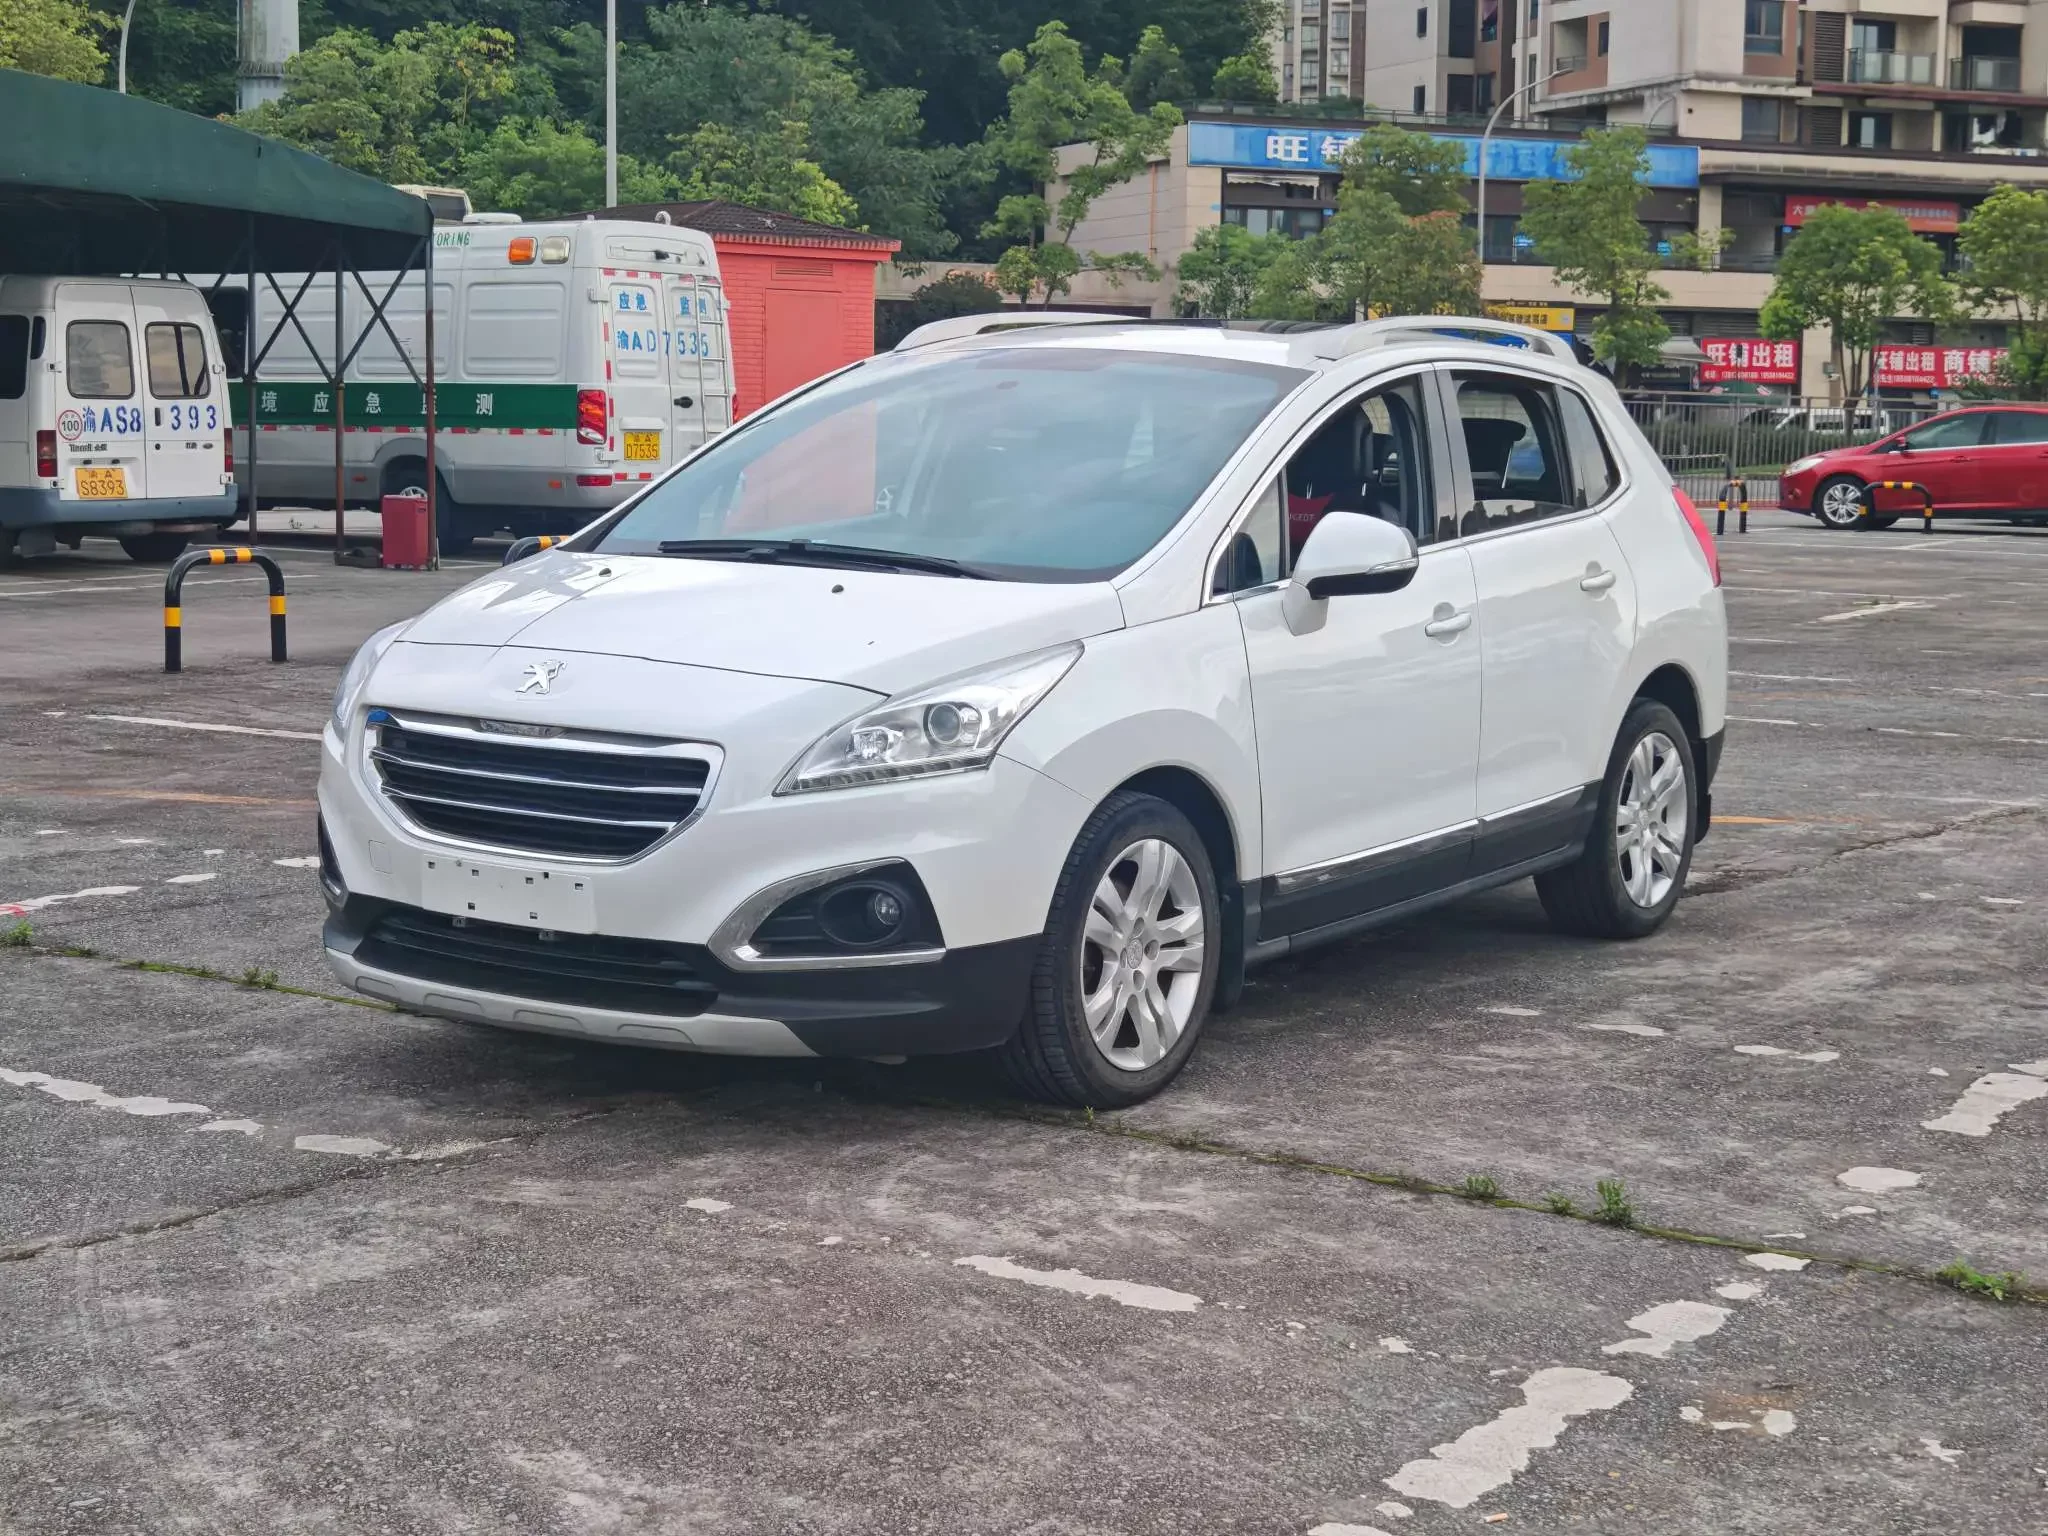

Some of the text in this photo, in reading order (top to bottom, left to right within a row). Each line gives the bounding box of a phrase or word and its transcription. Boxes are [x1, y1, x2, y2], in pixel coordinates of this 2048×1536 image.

[1706, 343, 1794, 367] 旺铺出租
[61, 420, 80, 432] 100
[80, 480, 125, 496] S8393
